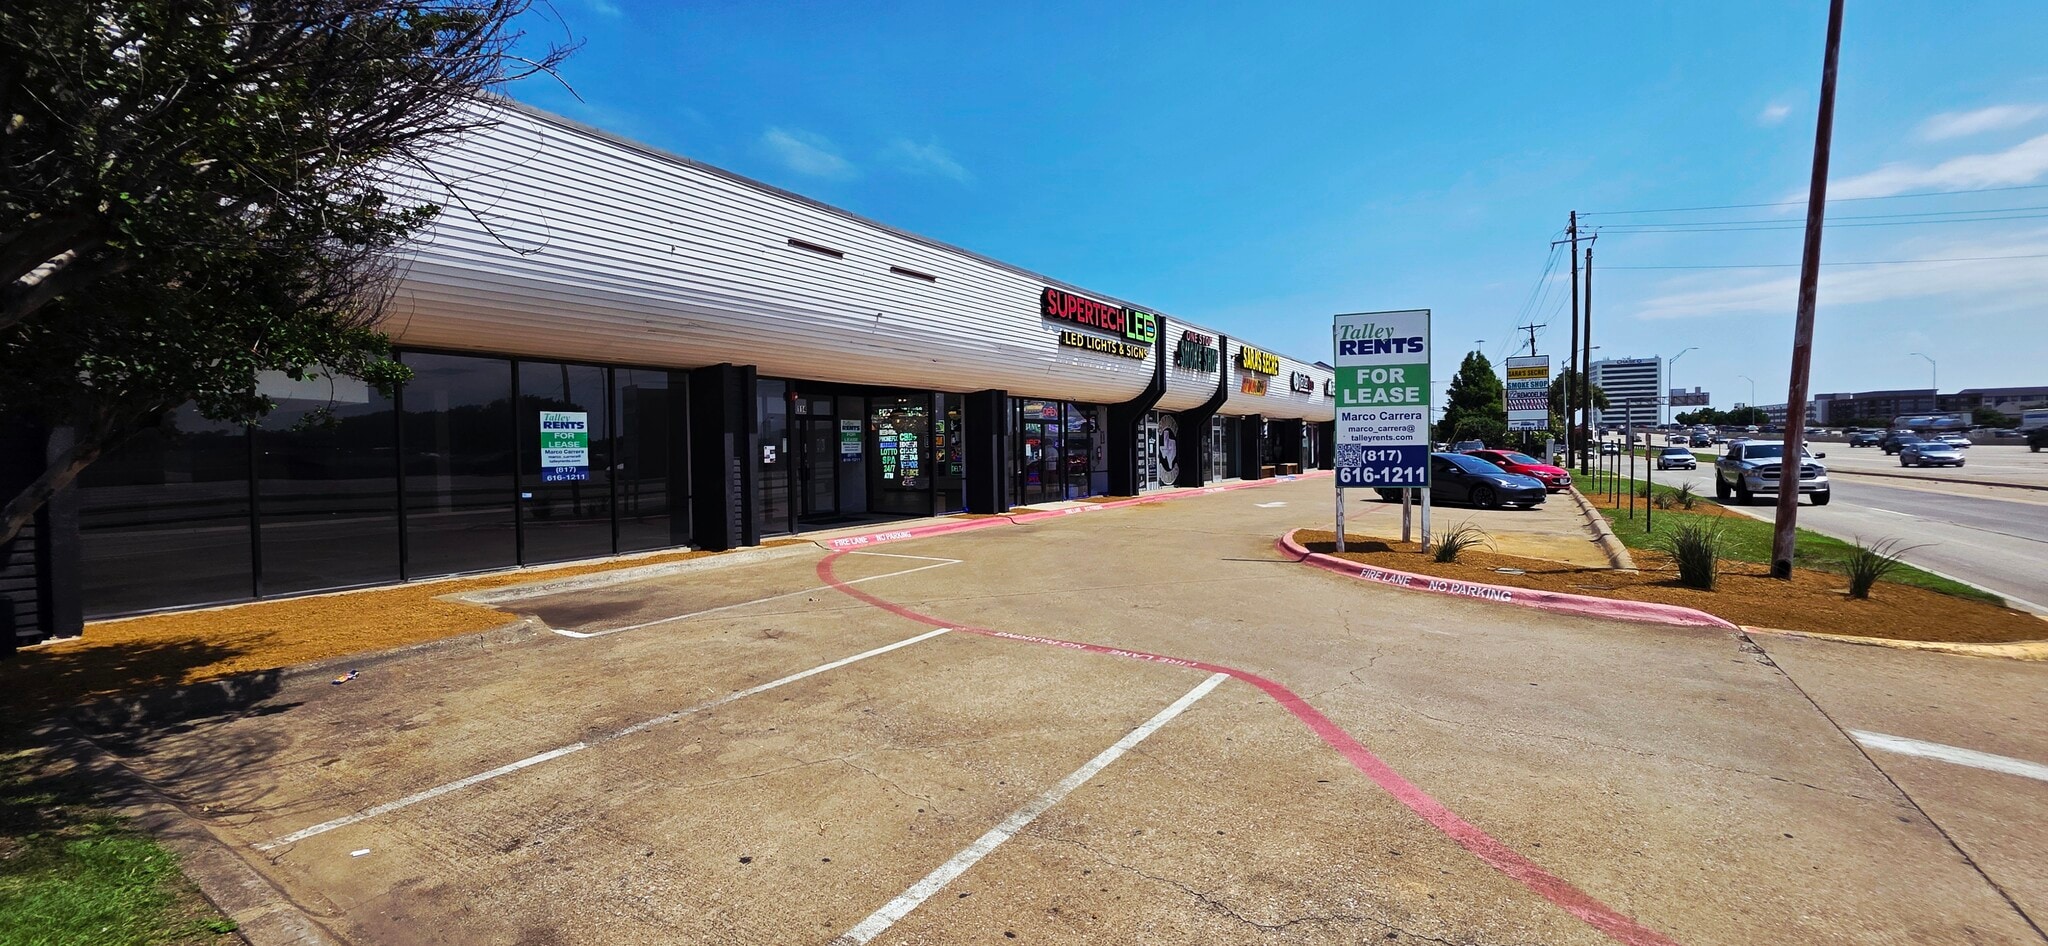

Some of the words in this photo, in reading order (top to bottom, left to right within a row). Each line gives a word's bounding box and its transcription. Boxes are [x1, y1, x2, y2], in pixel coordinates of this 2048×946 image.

[1047, 289, 1125, 333] SUPERTECH
[1186, 331, 1198, 343] ONE
[1198, 334, 1213, 346] STOP
[1340, 323, 1394, 341] Talley
[1065, 331, 1084, 347] LED
[1087, 336, 1117, 354] LIGHTS
[1118, 343, 1125, 355] &
[1126, 345, 1149, 360] SIGNS
[1340, 337, 1424, 356] RENTS
[1180, 340, 1202, 372] SMOKE
[1203, 347, 1219, 373] SHOP
[1357, 368, 1405, 384] FOR
[1530, 380, 1548, 388] SHOP
[1343, 387, 1420, 404] LEASE
[544, 413, 570, 422] Talley
[1341, 412, 1376, 421] Marco
[1379, 411, 1422, 421] Carrera
[543, 421, 585, 429] RENTS
[1348, 425, 1415, 433] marco_carrera@
[1351, 434, 1413, 442] talleyrents.com
[882, 456, 896, 464] SPA
[1362, 450, 1402, 464] (817)
[556, 466, 577, 474] (817)
[1340, 467, 1425, 483] 616-1211
[547, 474, 585, 482] 616-1211
[834, 539, 850, 547] FIRE
[850, 536, 868, 545] LANE
[886, 531, 912, 540] PARKING
[1360, 568, 1382, 580] FIRE
[1383, 572, 1412, 587] LANE
[1428, 580, 1448, 592] NO
[1450, 583, 1512, 602] PARKING
[1109, 649, 1153, 660] LANE
